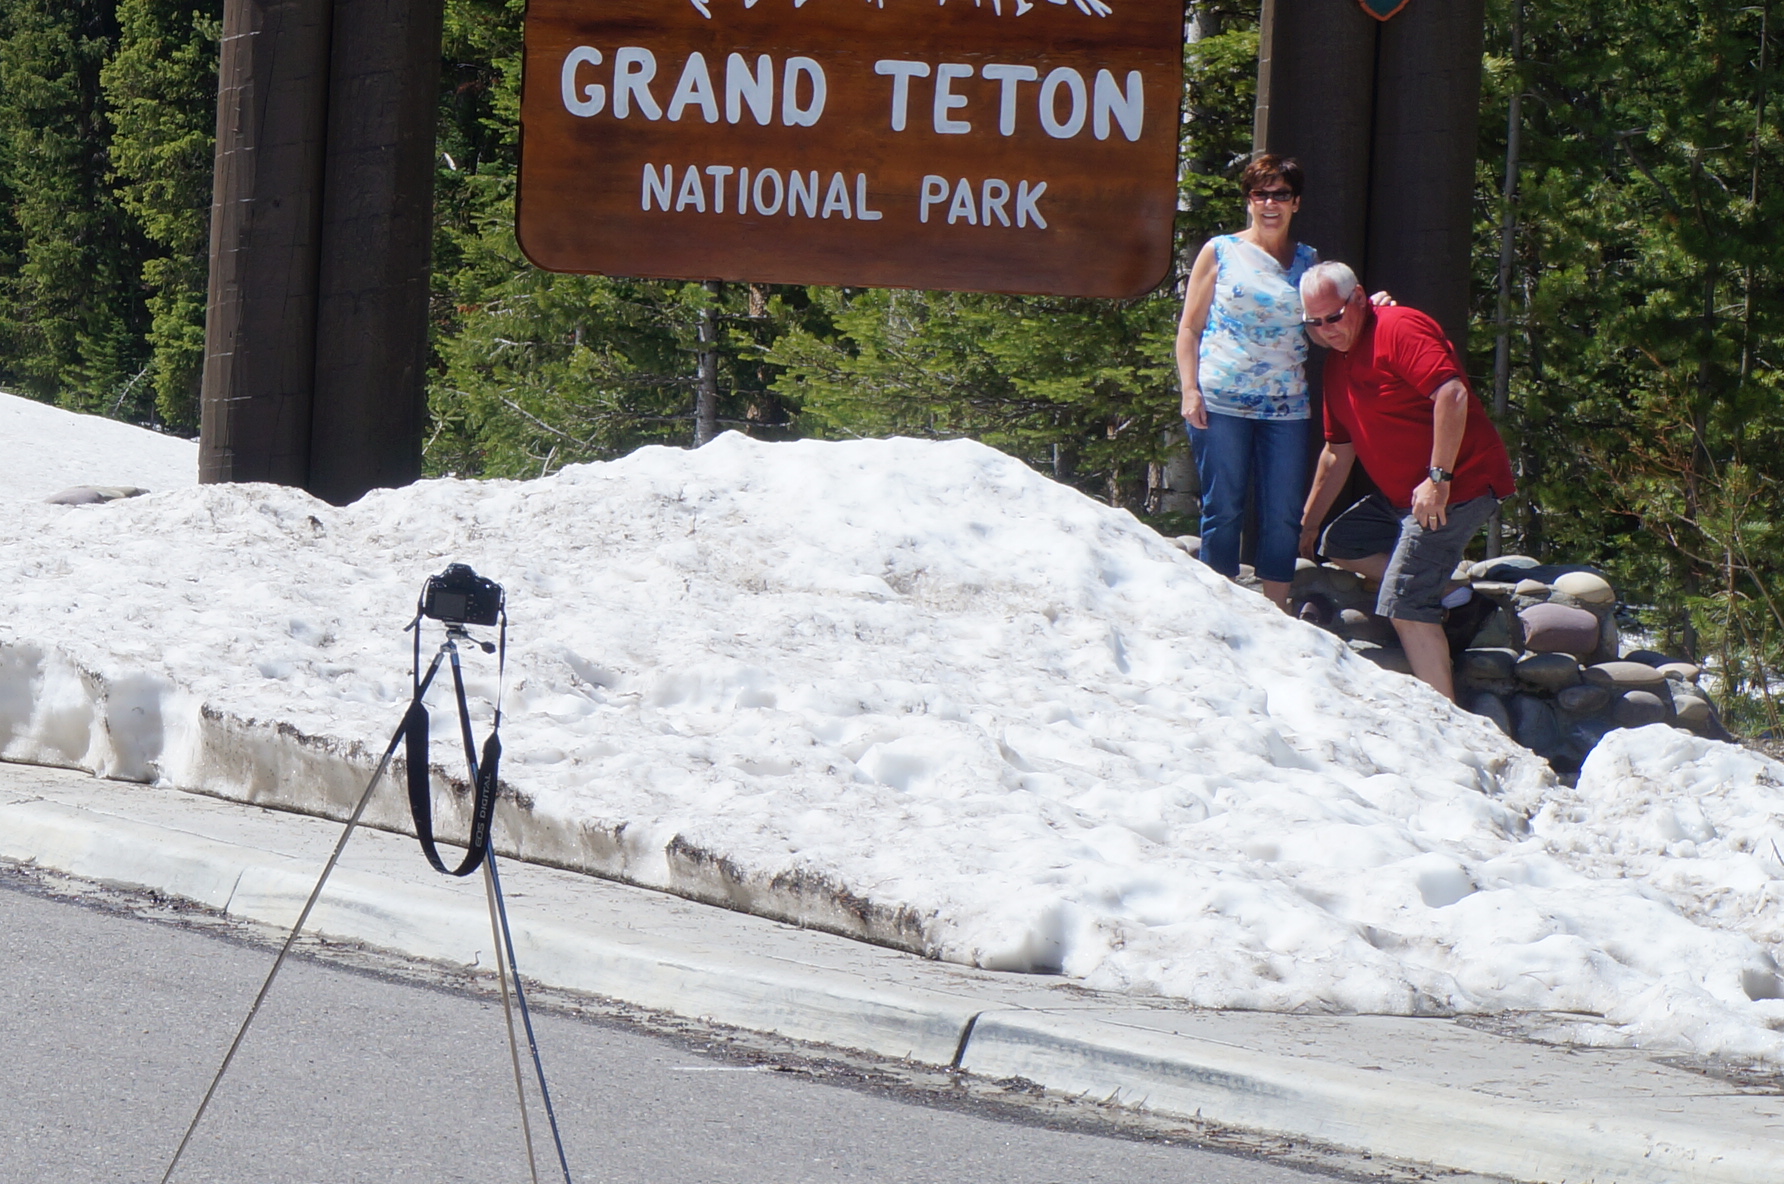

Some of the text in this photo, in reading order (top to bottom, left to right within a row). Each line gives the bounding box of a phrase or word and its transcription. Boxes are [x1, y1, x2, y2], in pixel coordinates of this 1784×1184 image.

[561, 45, 1144, 142] GRAND TETON
[641, 162, 1048, 230] NATIONAL PARK
[475, 773, 492, 848] EOS DIGITAL
